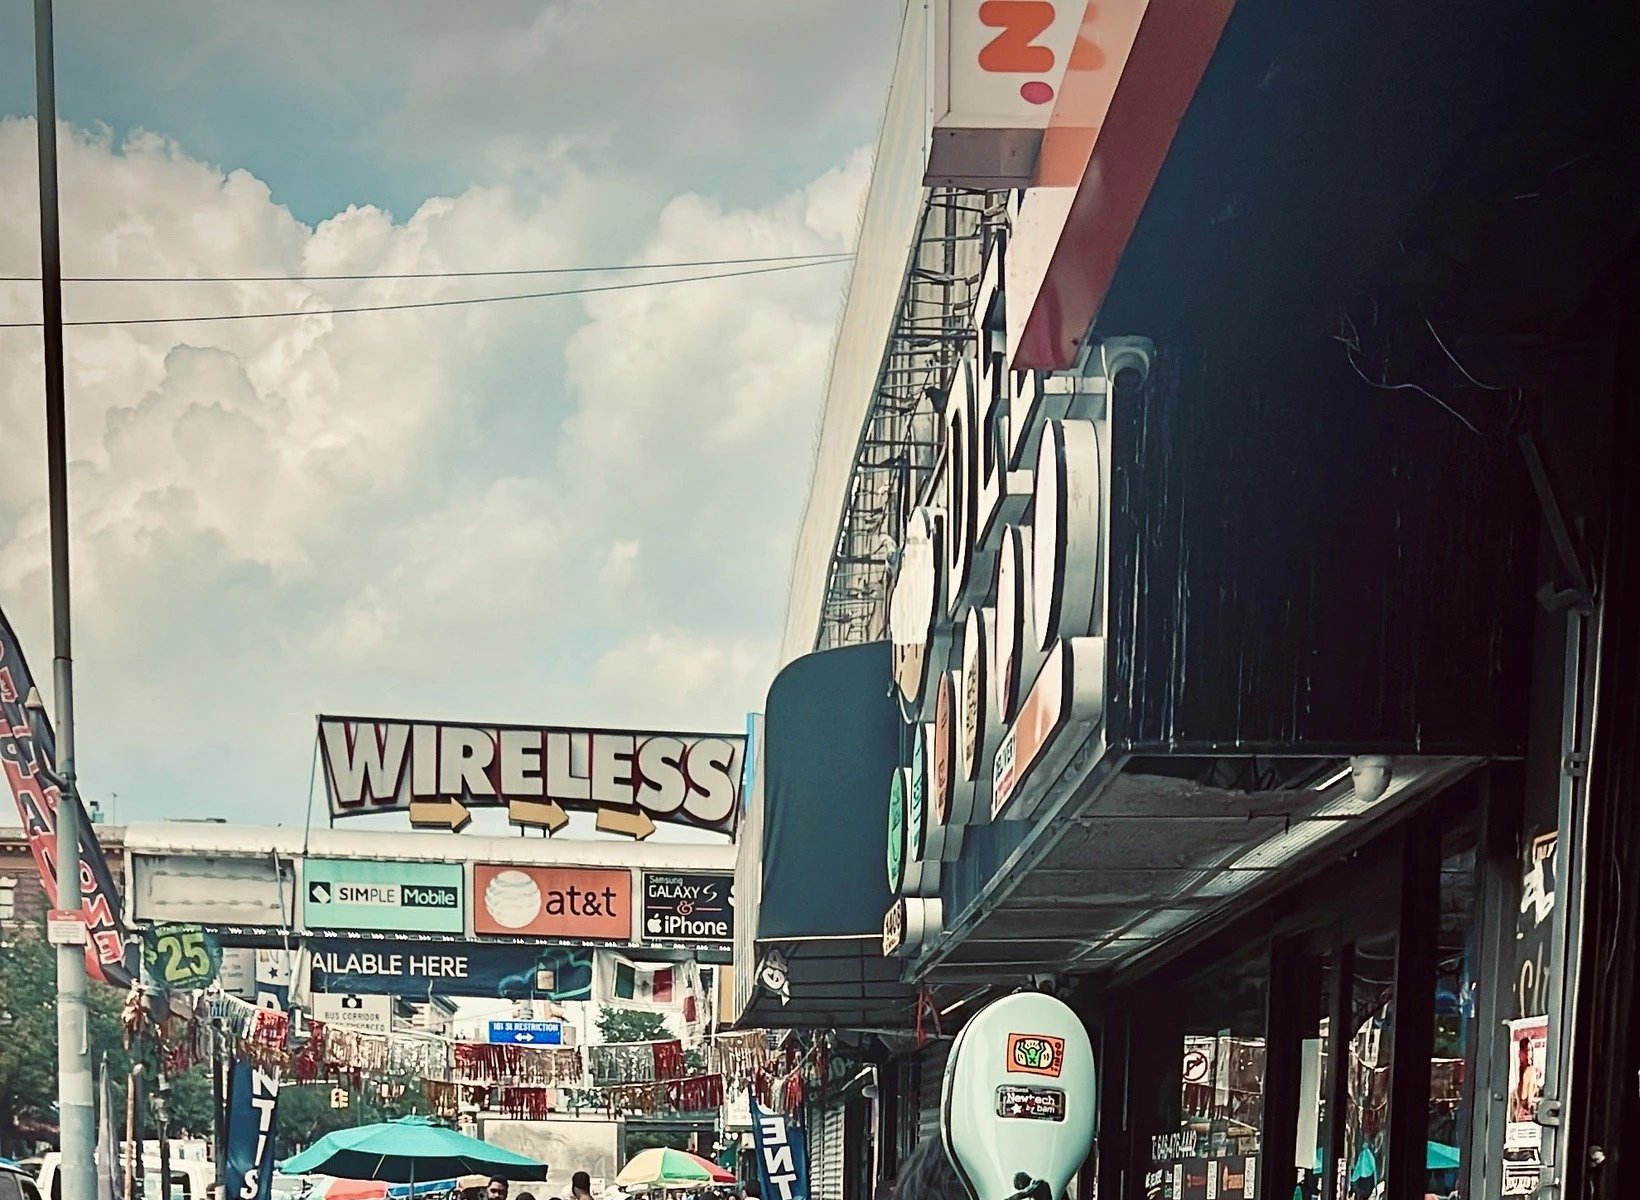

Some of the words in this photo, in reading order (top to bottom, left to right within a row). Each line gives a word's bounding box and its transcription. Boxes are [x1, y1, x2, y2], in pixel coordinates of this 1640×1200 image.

[321, 720, 737, 823] WIRELESS
[649, 875, 683, 885] Samsung
[339, 887, 395, 904] SIMPLE
[404, 887, 456, 906] Mobile
[545, 885, 617, 917] at&t
[649, 884, 700, 899] GALAXY
[664, 916, 728, 936] iPhone
[409, 956, 469, 978] HERE
[324, 1011, 340, 1020] BUS
[342, 1012, 381, 1021] CORRIDOR
